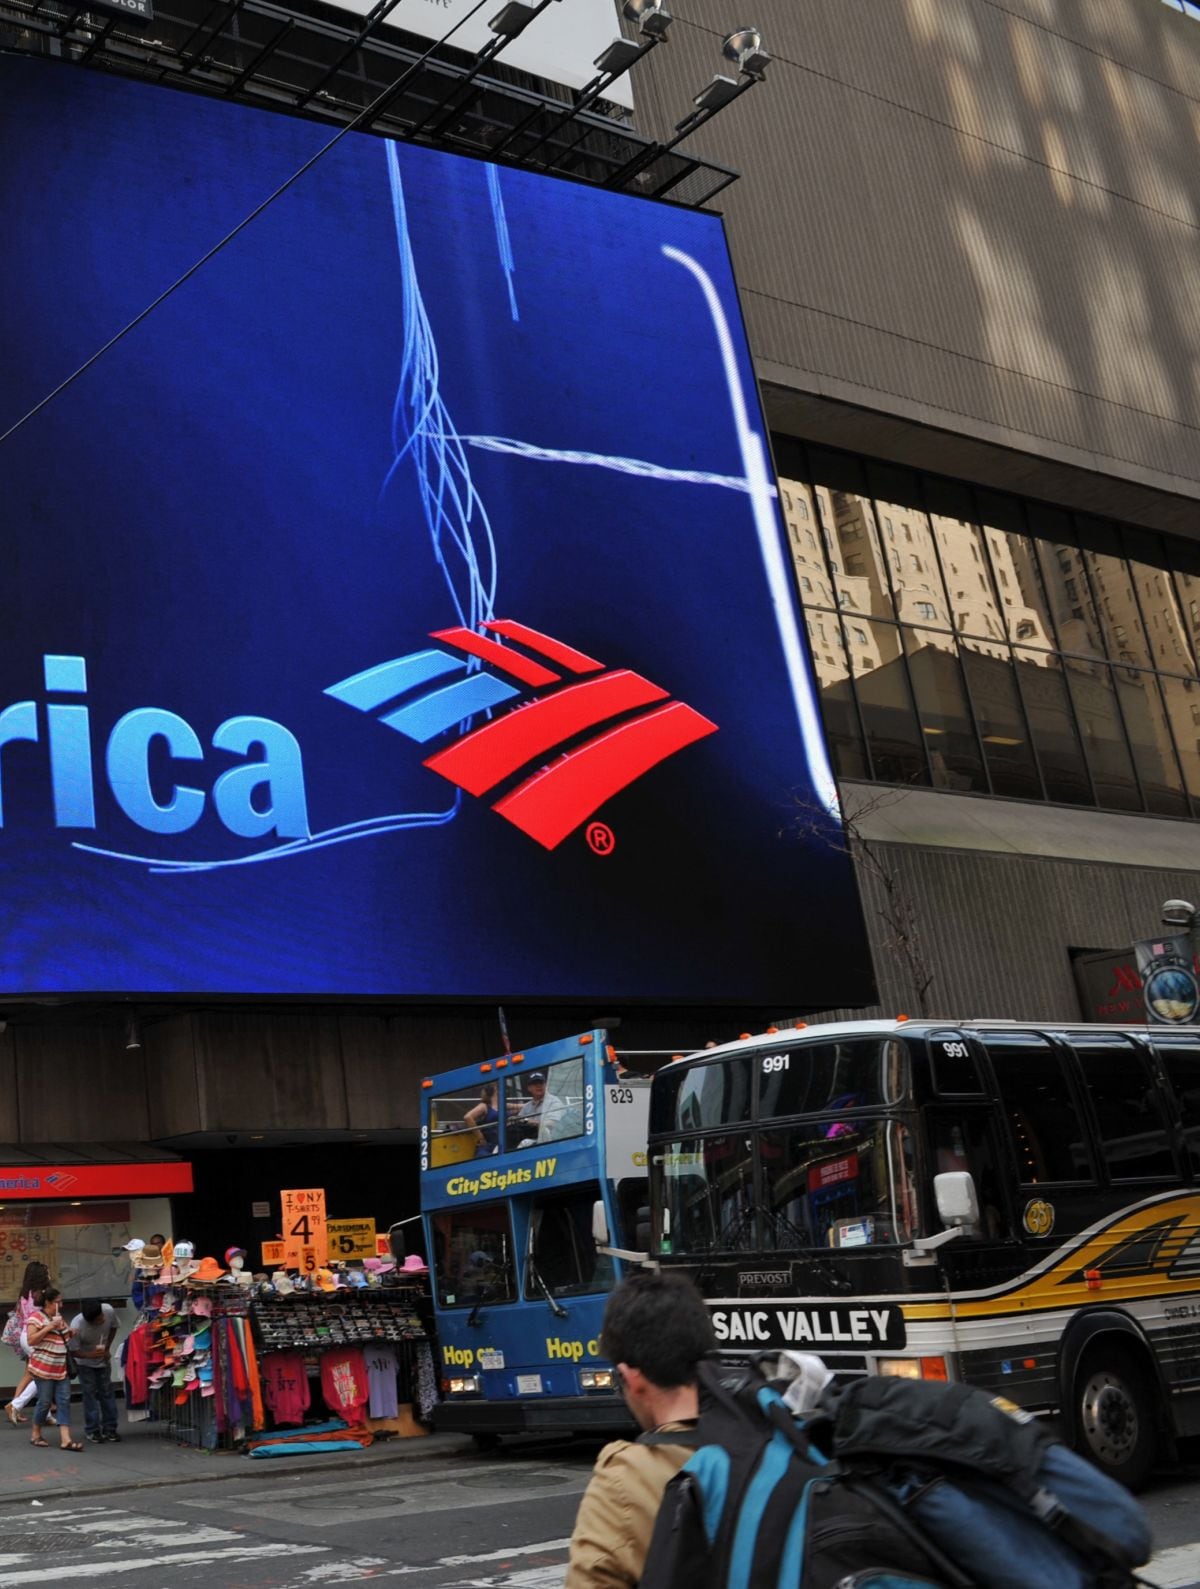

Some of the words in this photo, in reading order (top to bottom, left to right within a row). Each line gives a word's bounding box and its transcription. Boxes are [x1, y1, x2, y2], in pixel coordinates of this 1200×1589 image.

[942, 1042, 969, 1058] 991
[763, 1054, 791, 1073] 991
[610, 1088, 634, 1104] 829
[585, 1085, 595, 1136] 829
[420, 1125, 429, 1171] 829
[535, 1158, 557, 1179] NY
[305, 1255, 316, 1272] 5
[739, 1273, 789, 1285] PREVOST
[712, 1311, 771, 1341] SAIC
[776, 1310, 890, 1342] VALLEY
[443, 1346, 474, 1369] Hop
[546, 1337, 584, 1363] Hop
